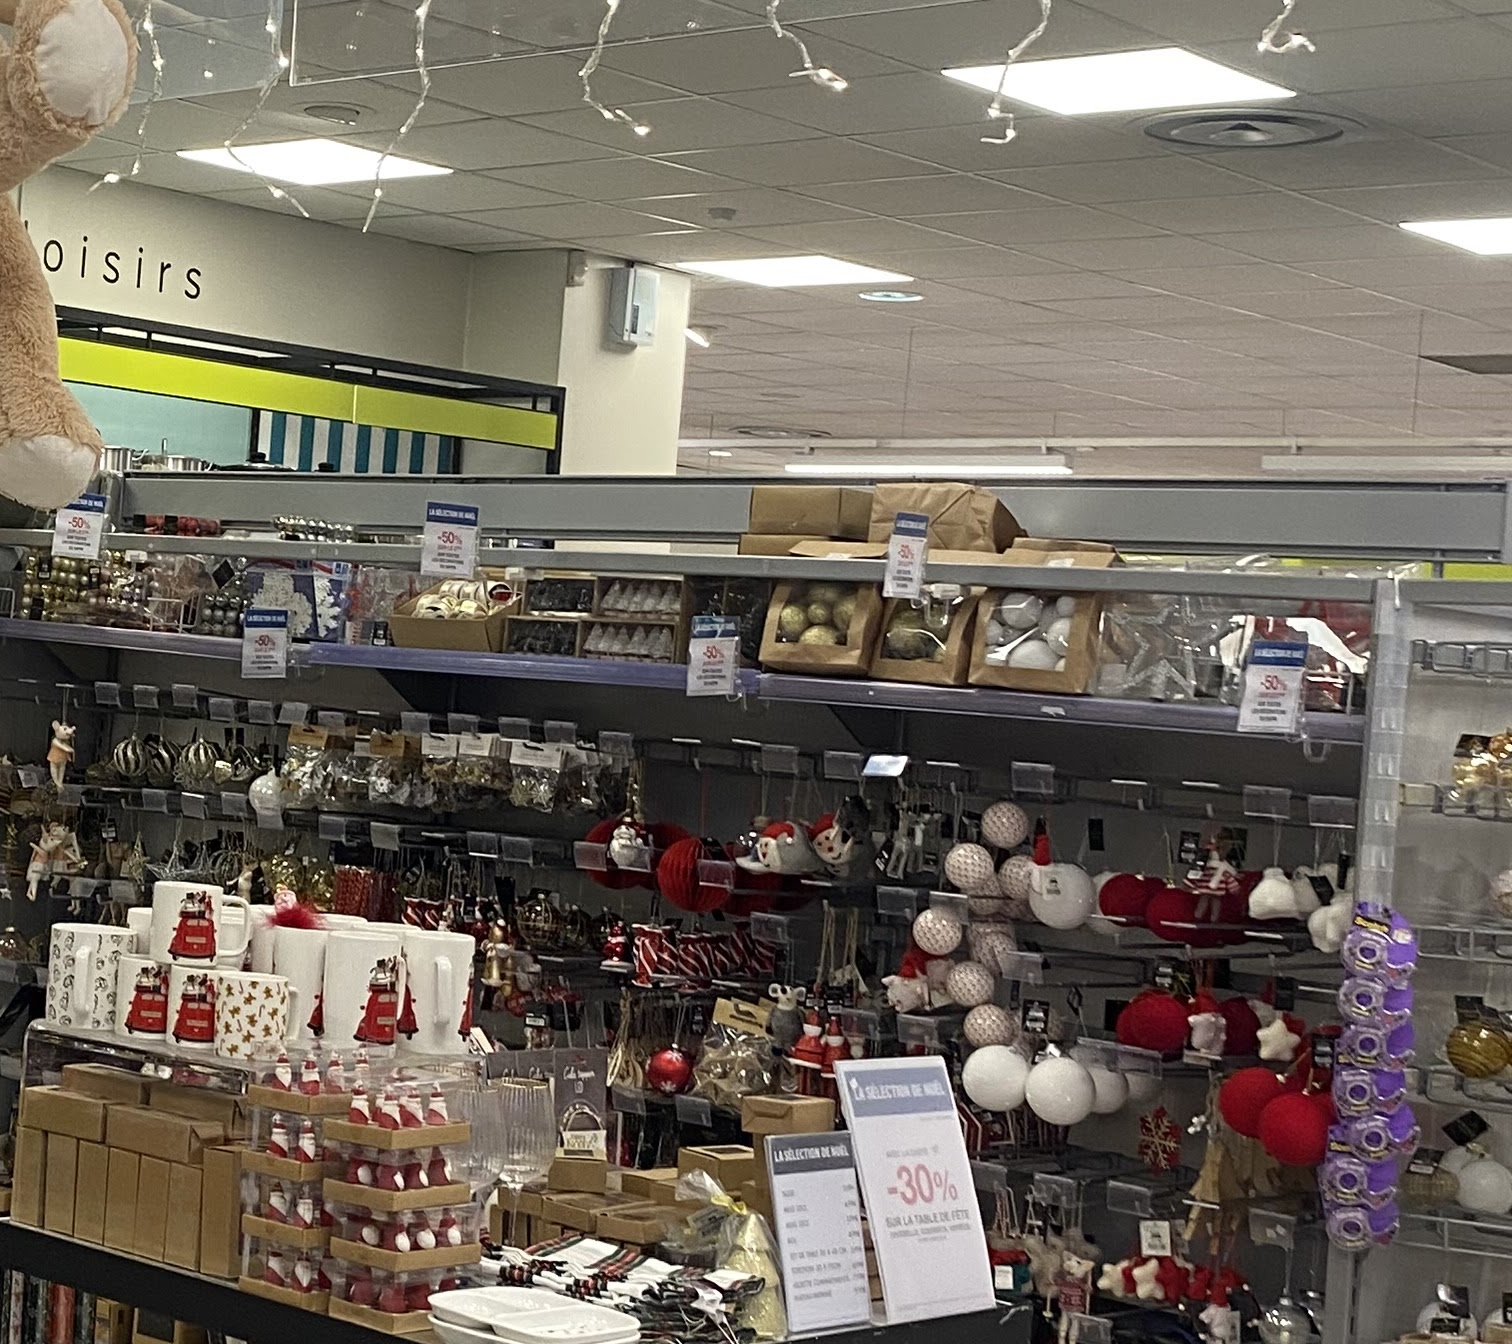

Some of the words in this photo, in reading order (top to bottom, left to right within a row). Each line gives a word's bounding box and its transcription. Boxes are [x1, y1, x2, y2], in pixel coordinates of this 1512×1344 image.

[25, 220, 202, 299] oisirs
[854, 1086, 866, 1101] LA
[866, 1082, 911, 1100] SÉLECTION
[910, 1083, 924, 1097] DE
[774, 1150, 784, 1162] LA
[784, 1146, 820, 1162] SÉLECTION
[820, 1146, 830, 1158] DE
[831, 1143, 849, 1157] NOËL
[888, 1163, 958, 1206] -30%
[886, 1216, 902, 1228] SUR
[903, 1215, 914, 1226] LA
[914, 1212, 939, 1225] TABLE
[939, 1211, 950, 1222] DE
